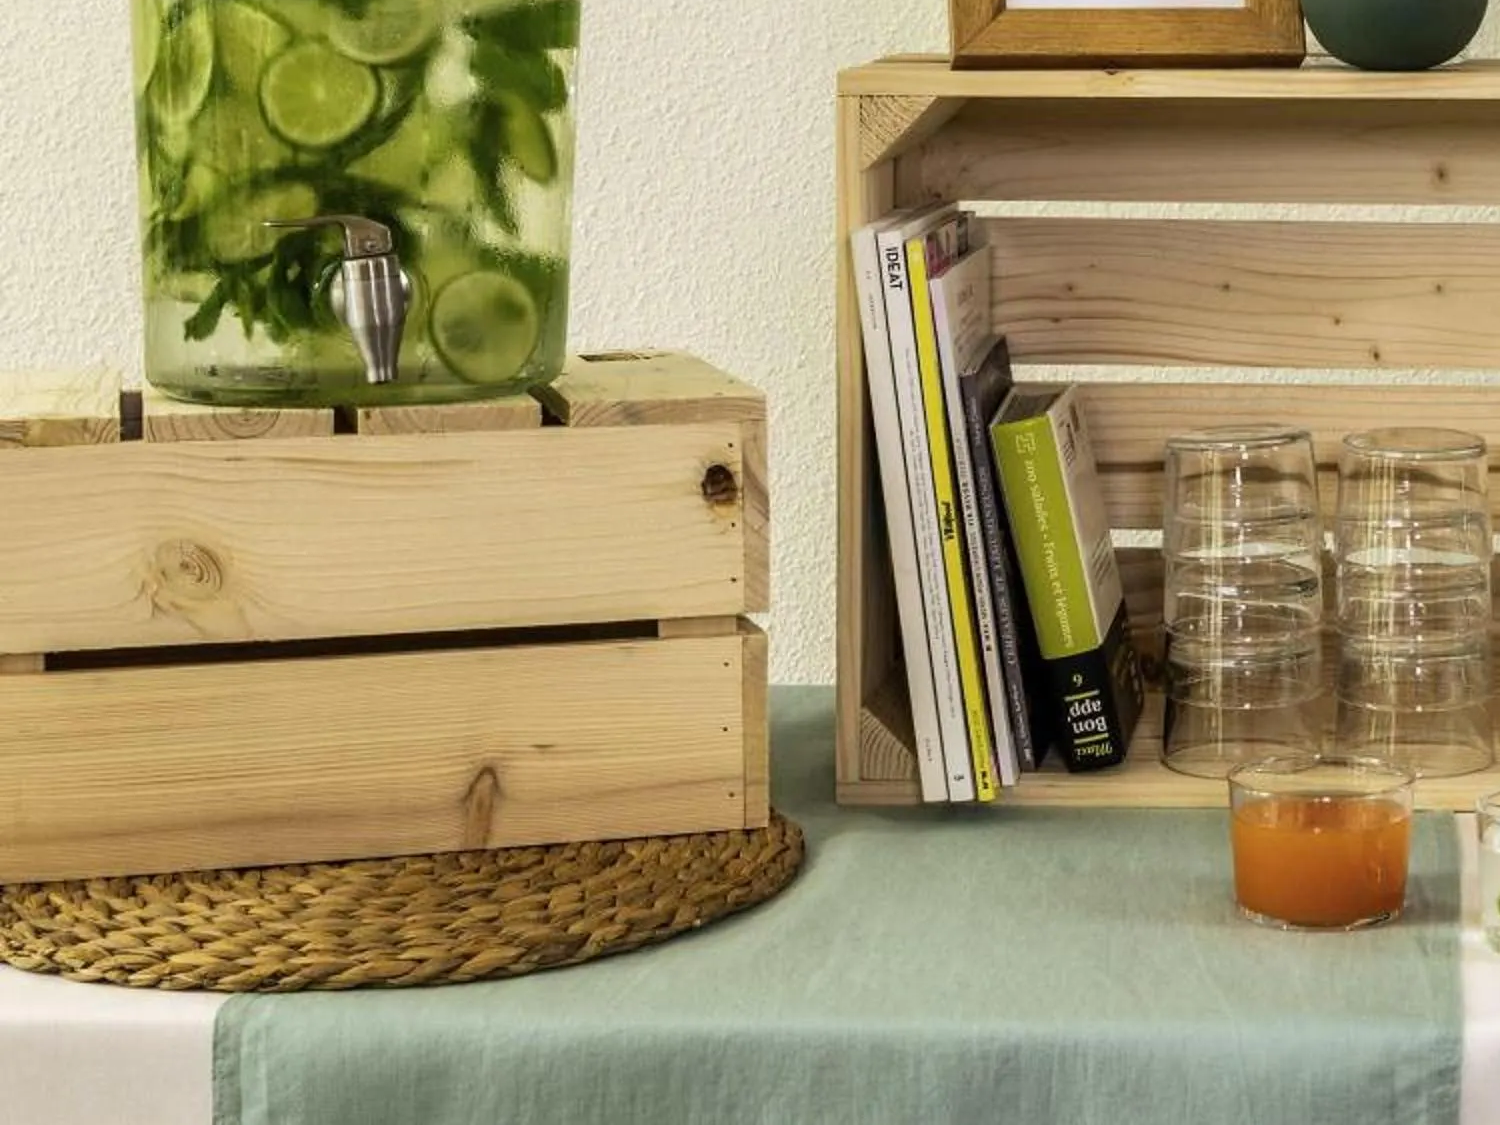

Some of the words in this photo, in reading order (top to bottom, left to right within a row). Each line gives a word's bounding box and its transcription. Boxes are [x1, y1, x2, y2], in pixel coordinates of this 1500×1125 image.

[885, 246, 902, 291] IDEAT
[1030, 483, 1048, 531] salades
[1052, 581, 1063, 596] et
[1067, 699, 1102, 723] app'
[1072, 716, 1107, 734] Bon
